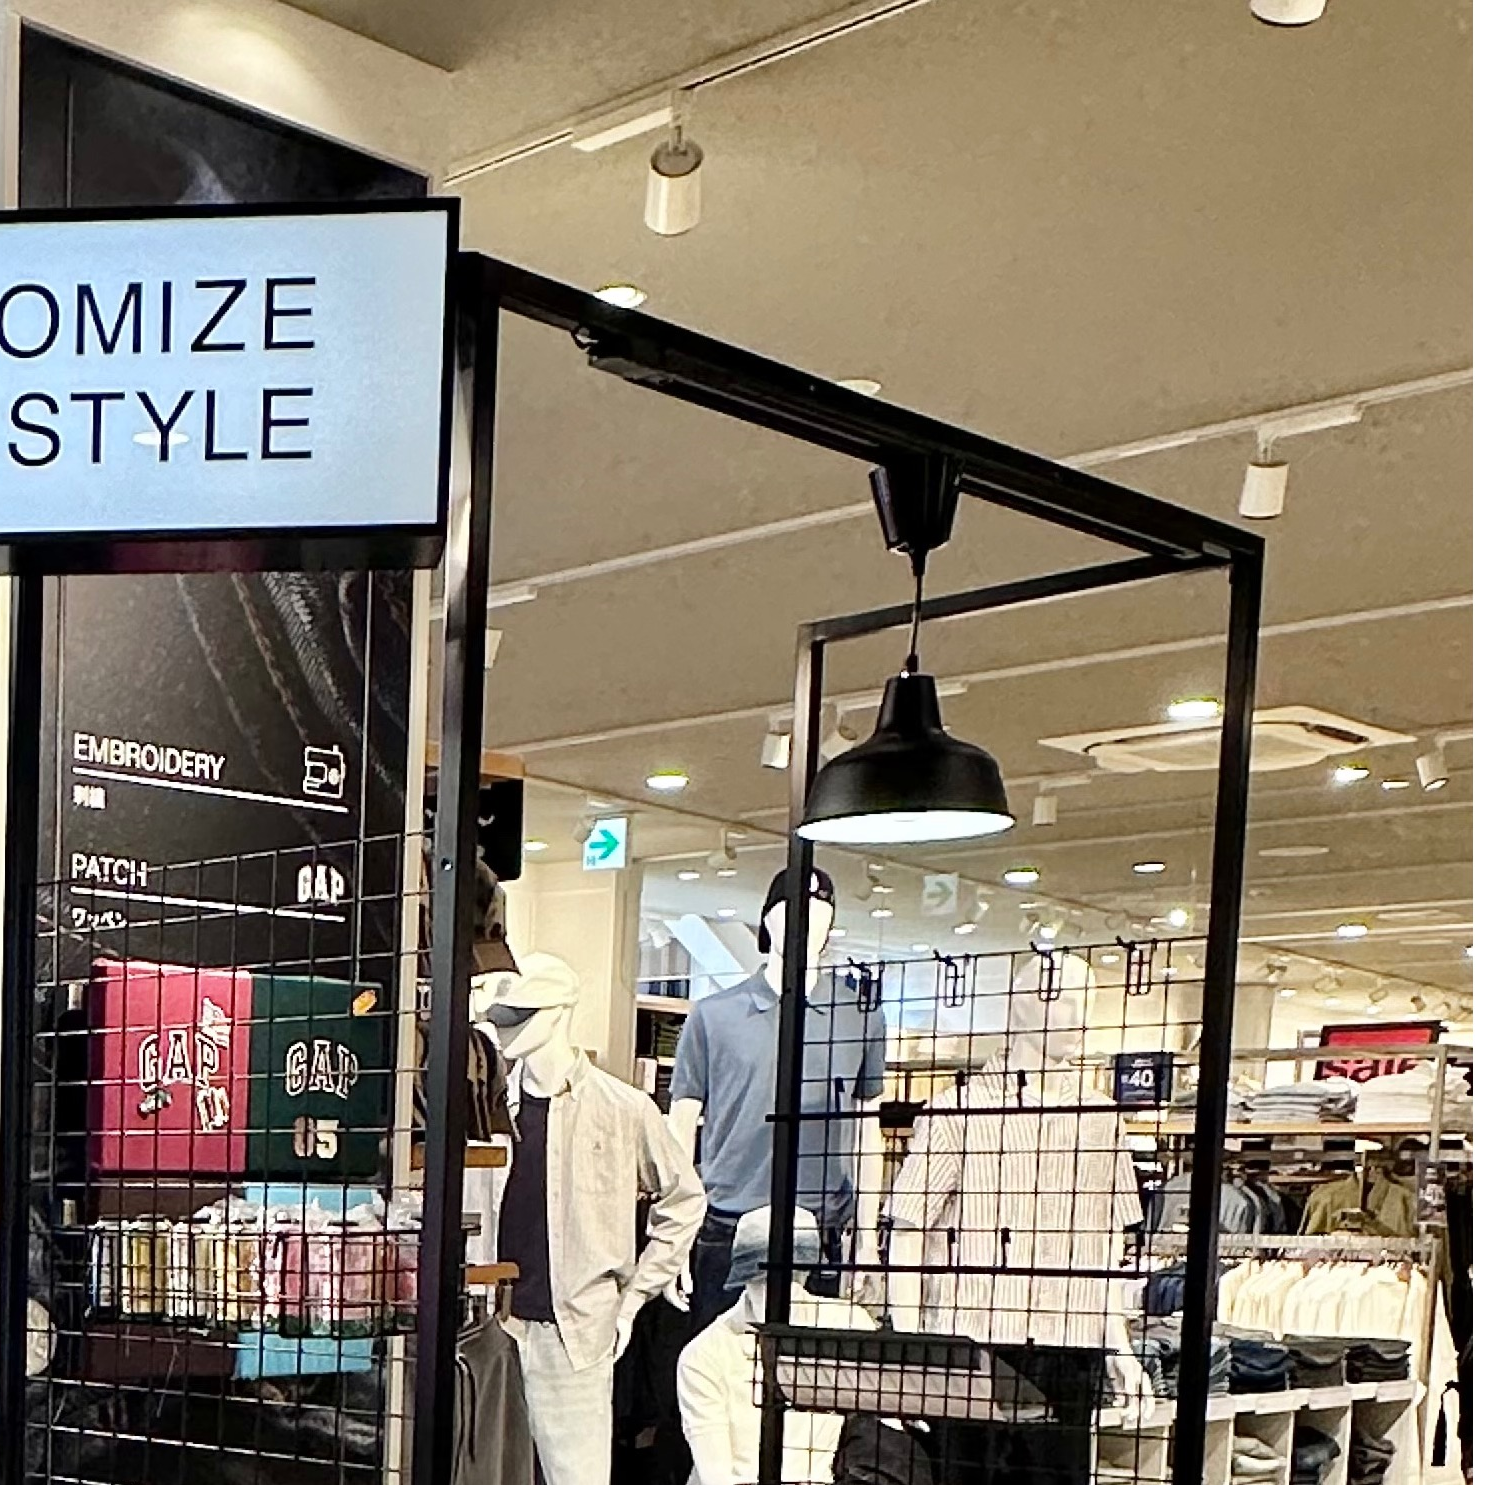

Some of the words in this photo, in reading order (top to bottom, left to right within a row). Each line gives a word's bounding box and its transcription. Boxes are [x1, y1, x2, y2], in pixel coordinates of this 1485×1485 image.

[7, 386, 315, 467] STYLE
[72, 732, 226, 782] EMBROIDERY
[71, 852, 148, 887] PATCH
[297, 864, 346, 906] GAP
[138, 1028, 220, 1094] GAP
[284, 1038, 359, 1100] GAP
